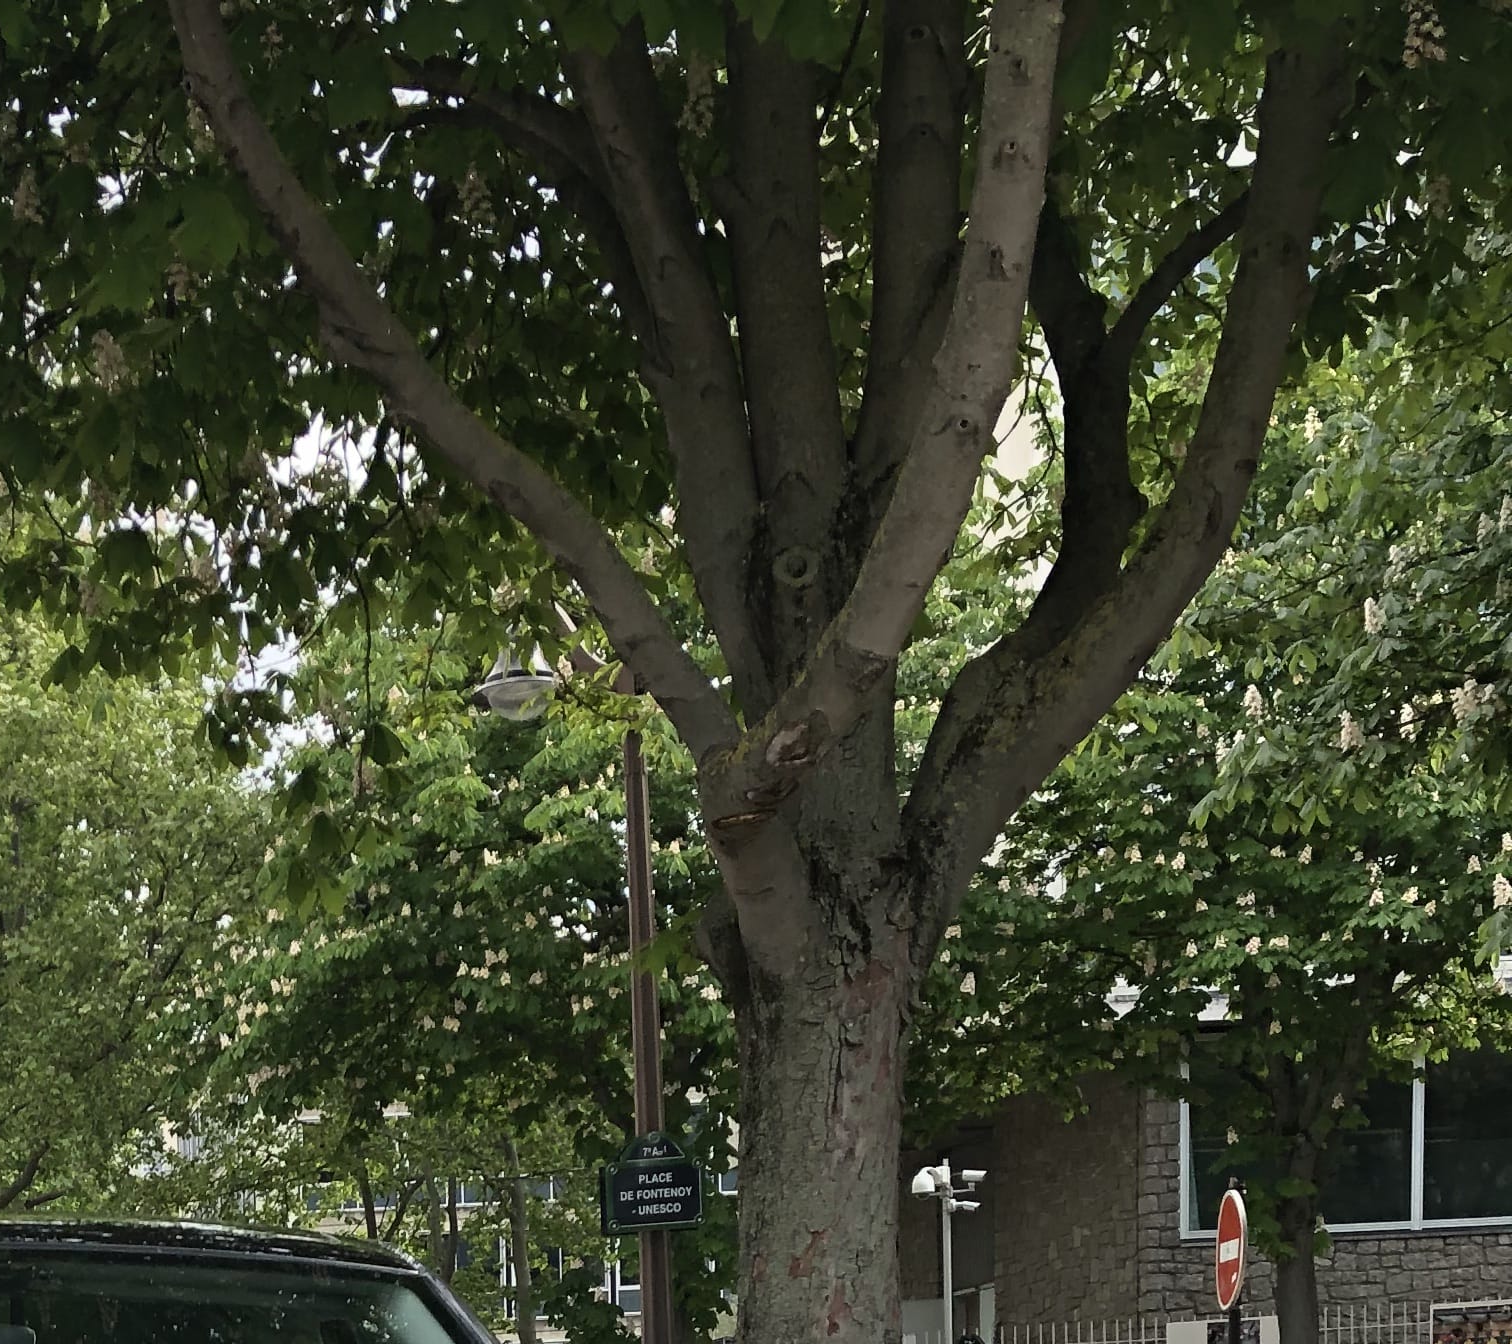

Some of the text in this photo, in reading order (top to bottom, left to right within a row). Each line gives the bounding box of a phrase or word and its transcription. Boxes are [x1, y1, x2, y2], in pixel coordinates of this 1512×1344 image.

[638, 1172, 673, 1184] PLACE
[620, 1186, 692, 1201] DE FONTENOY
[638, 1202, 682, 1215] UNESCO
